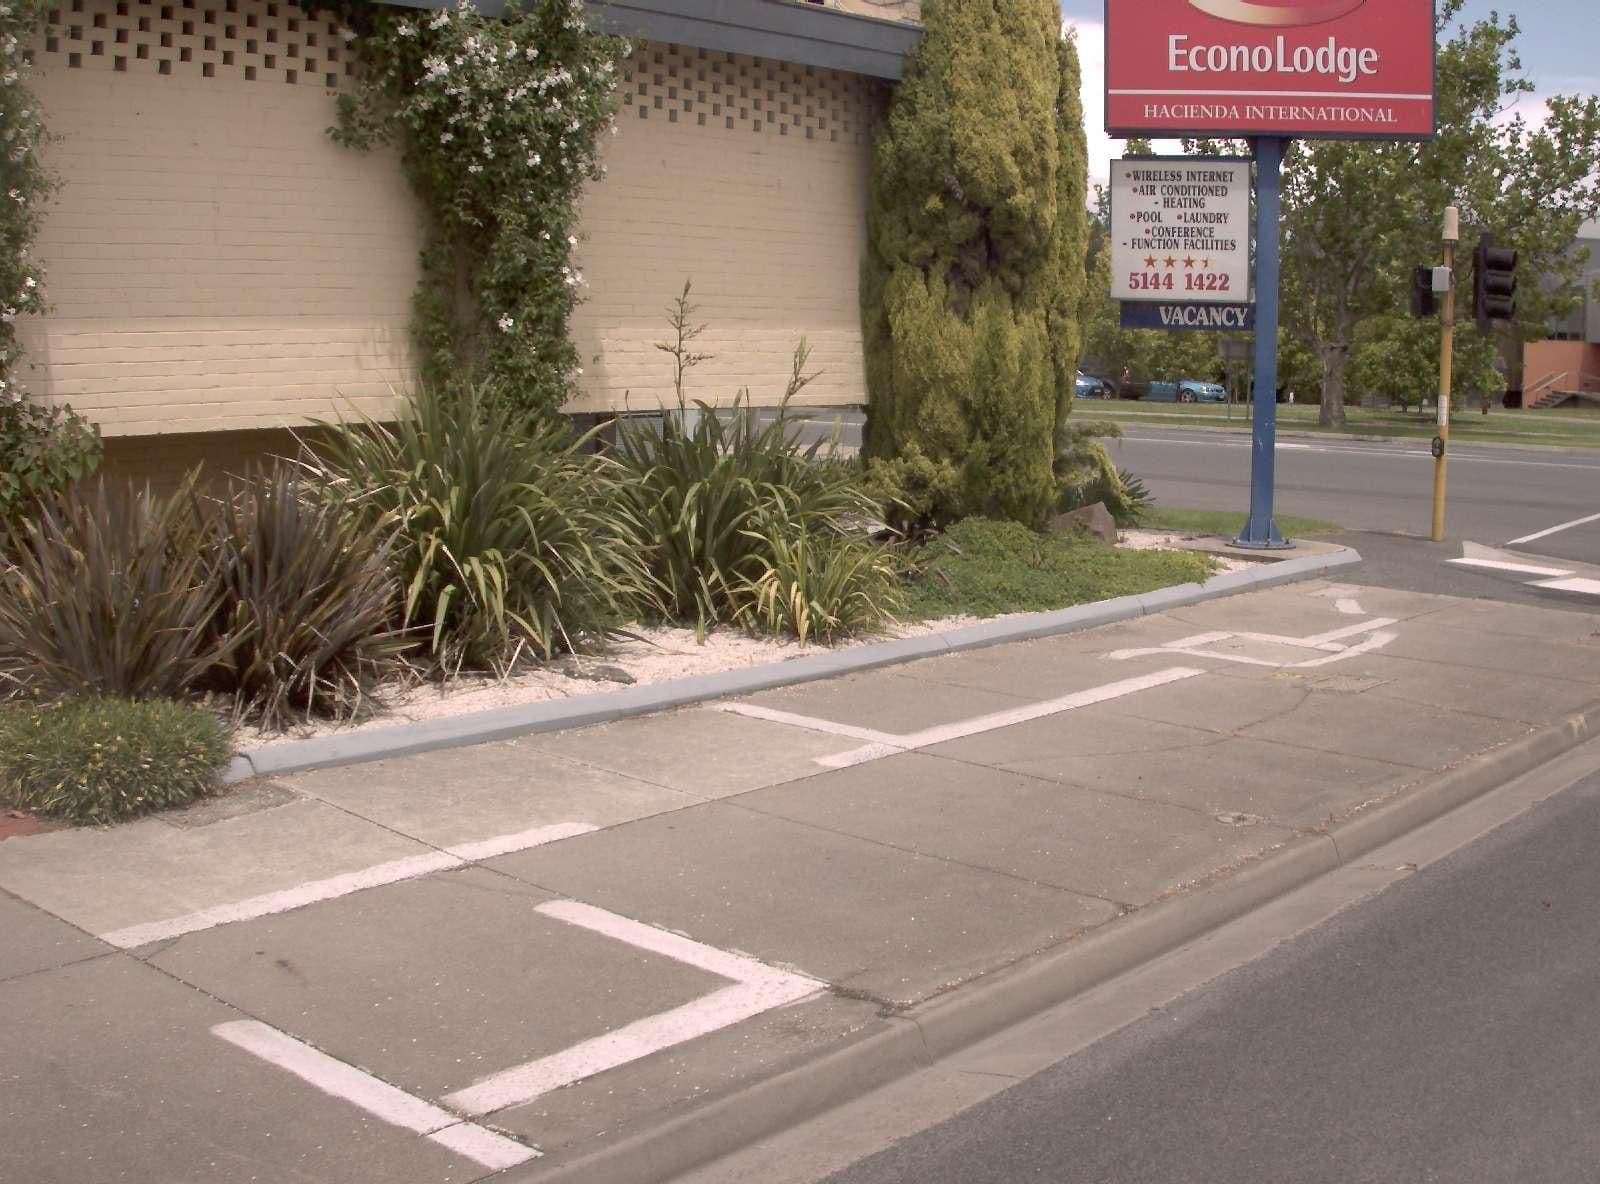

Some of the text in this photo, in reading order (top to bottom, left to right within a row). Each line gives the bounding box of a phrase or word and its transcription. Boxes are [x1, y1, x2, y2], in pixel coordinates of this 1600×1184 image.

[1168, 34, 1378, 82] EconoLodge
[1144, 105, 1397, 122] HACIENDA INTERNATIONAL
[1132, 171, 1234, 182] WIRELESS INTERNET
[1139, 185, 1228, 196] AIR CONDITIONED
[1163, 198, 1205, 208] HEATING
[1136, 212, 1162, 222] POOL
[1184, 212, 1229, 223] LAUNDRY
[1152, 227, 1214, 237] CONFERENCE
[1184, 240, 1236, 250] FACILITIES
[1129, 272, 1229, 290] 5144 1422
[1160, 306, 1247, 326] VACANCY
